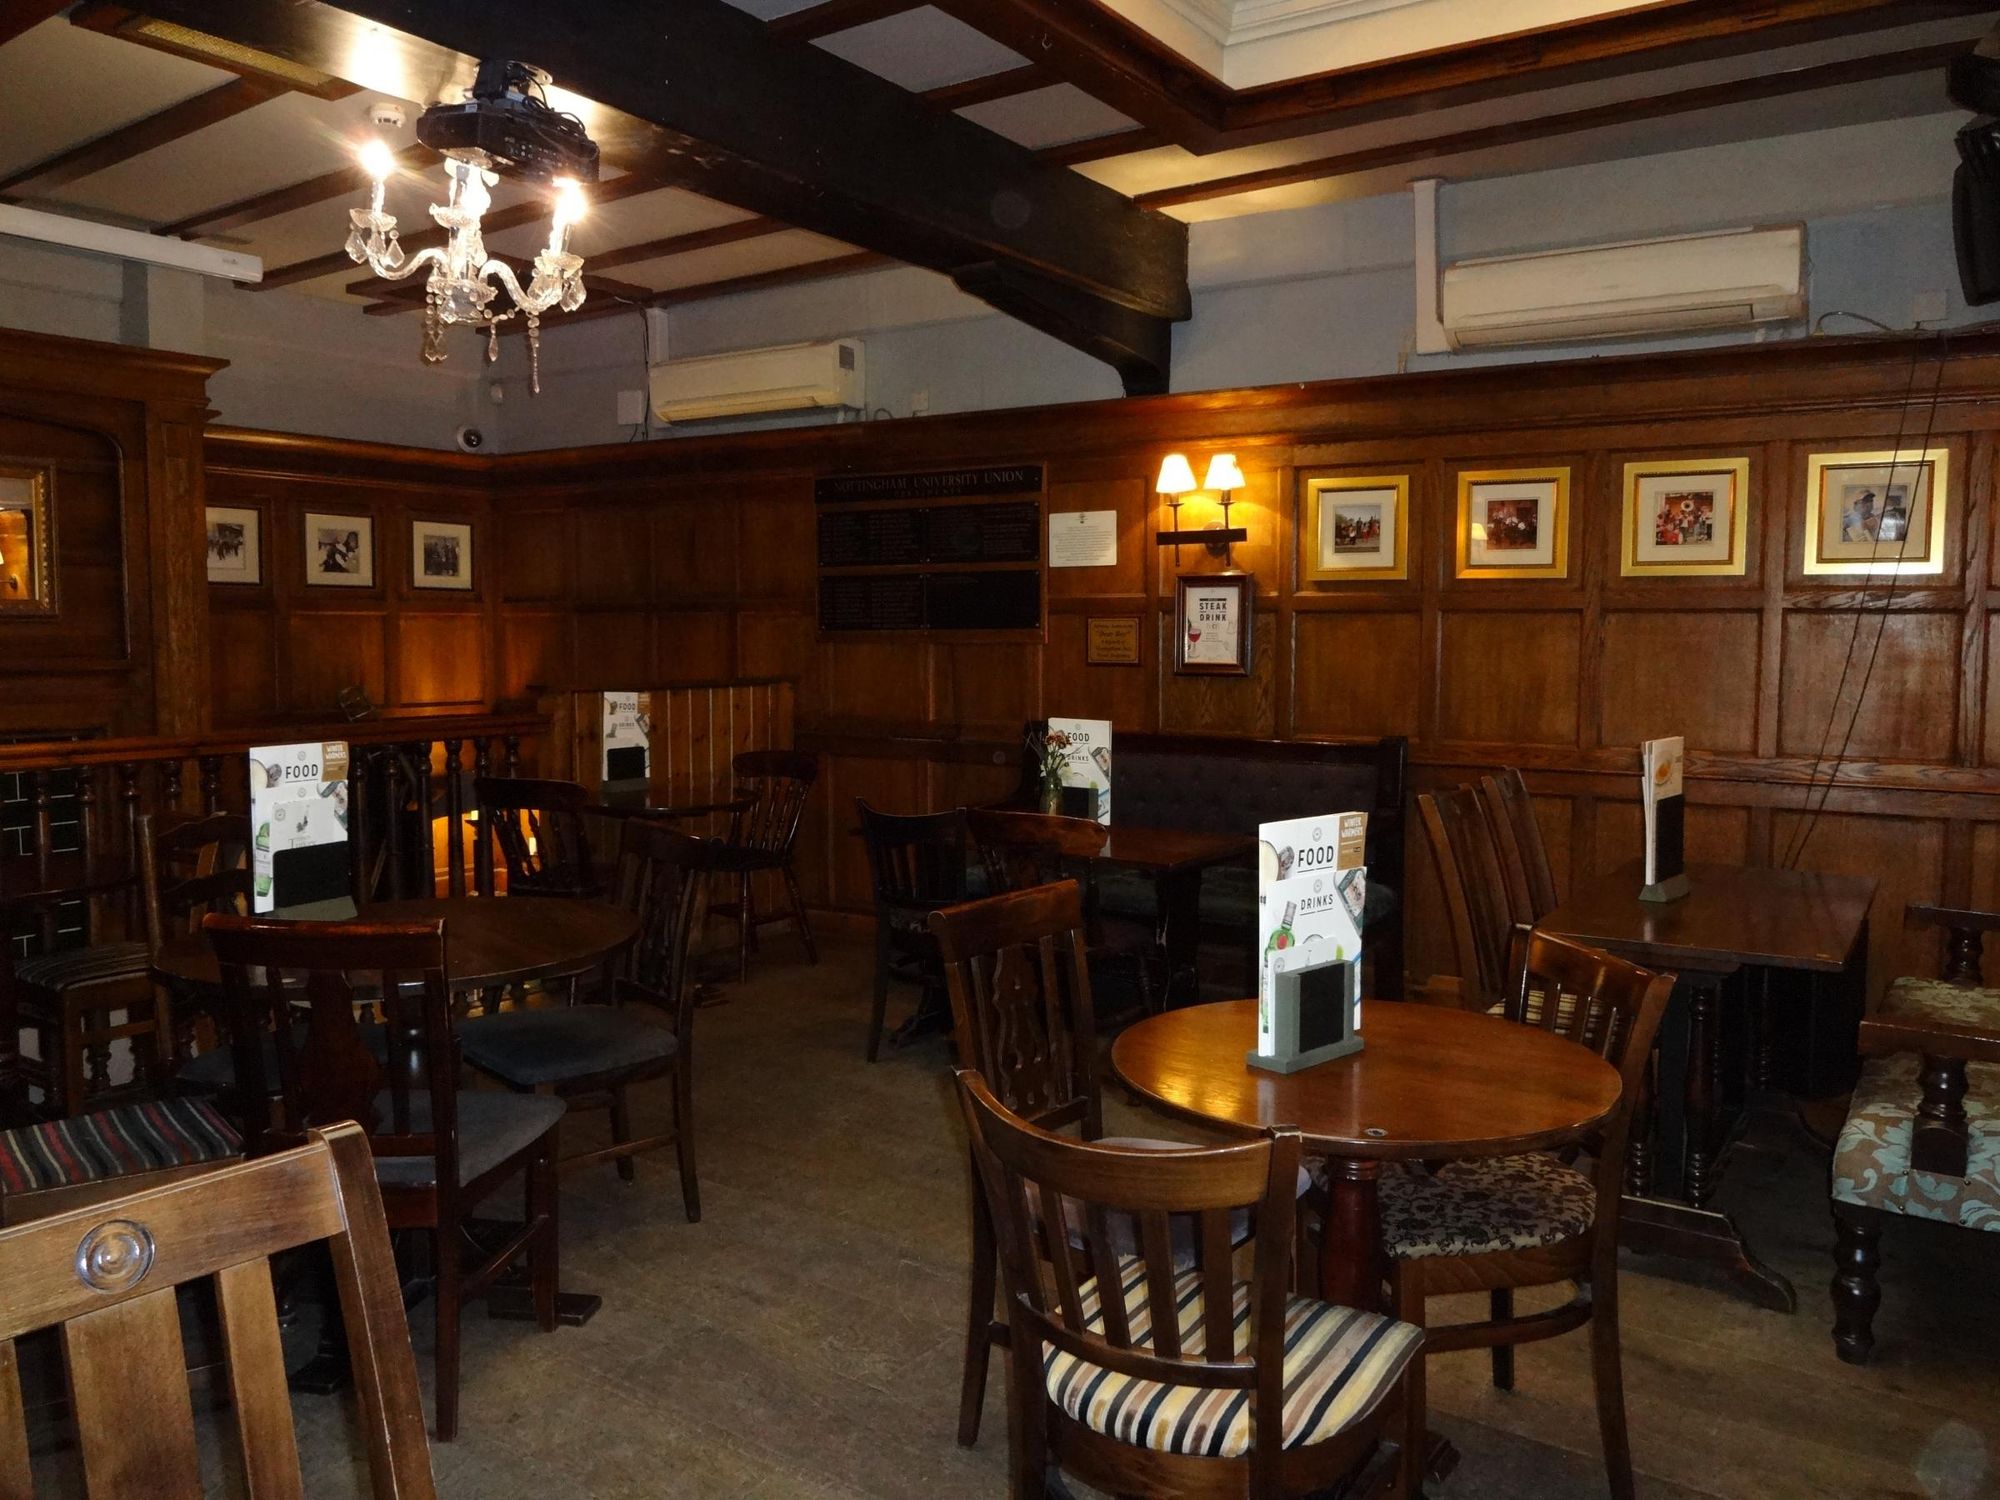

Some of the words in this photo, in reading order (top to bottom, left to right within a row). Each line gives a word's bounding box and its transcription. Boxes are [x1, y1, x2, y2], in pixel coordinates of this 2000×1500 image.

[834, 478, 907, 493] NOTTINGHAM
[913, 473, 978, 489] UNIVERSITY
[984, 470, 1024, 484] UNION
[1199, 602, 1227, 610] STEAK
[1199, 613, 1227, 622] DRINK
[619, 703, 636, 711] FOOD
[1067, 732, 1090, 742] FOOD
[286, 764, 318, 779] FOOD
[1344, 817, 1362, 828] WINTER
[1298, 846, 1333, 868] FOOD
[1301, 894, 1333, 911] DRINKS
